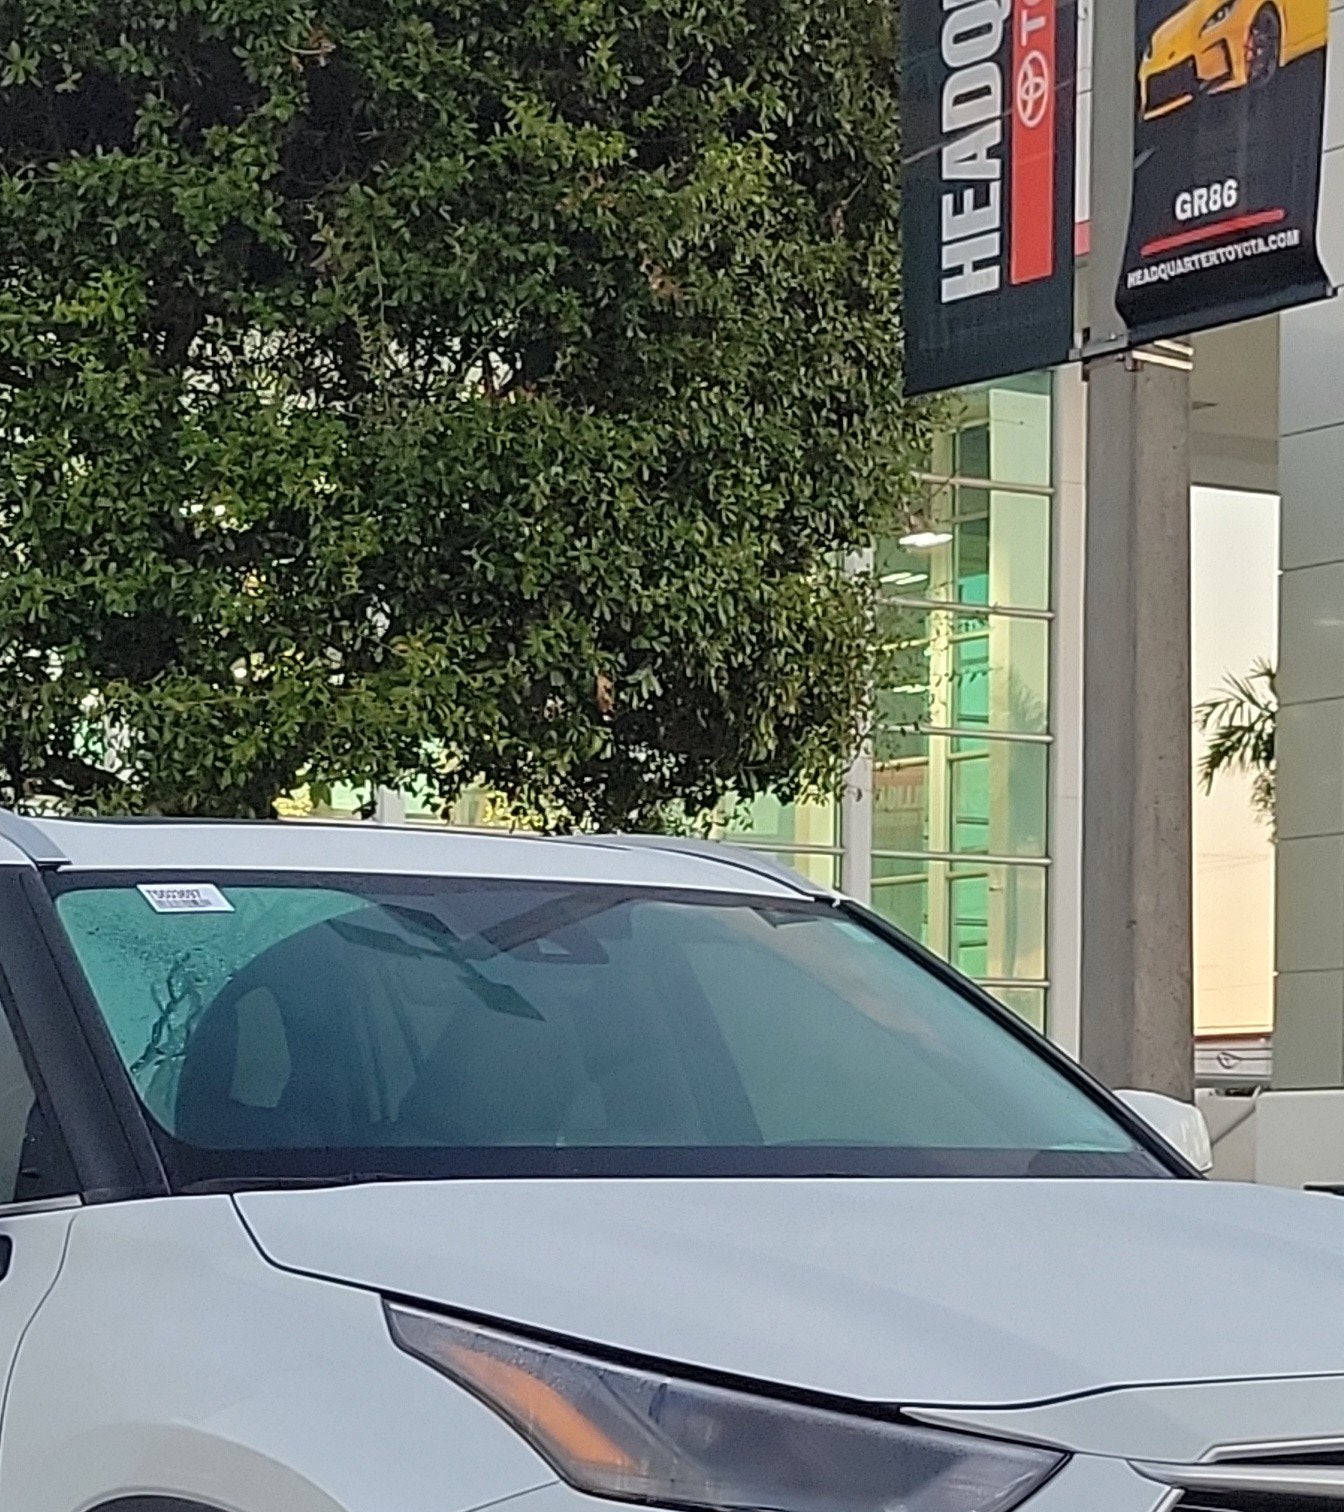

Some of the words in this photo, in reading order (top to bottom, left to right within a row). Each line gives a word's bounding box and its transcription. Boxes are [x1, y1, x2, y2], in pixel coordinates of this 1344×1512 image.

[1020, 0, 1046, 47] T
[941, 0, 1011, 304] HEADQ
[1174, 178, 1239, 221] GR86
[1126, 228, 1301, 289] HEADQUARTERTOYOTA.COM
